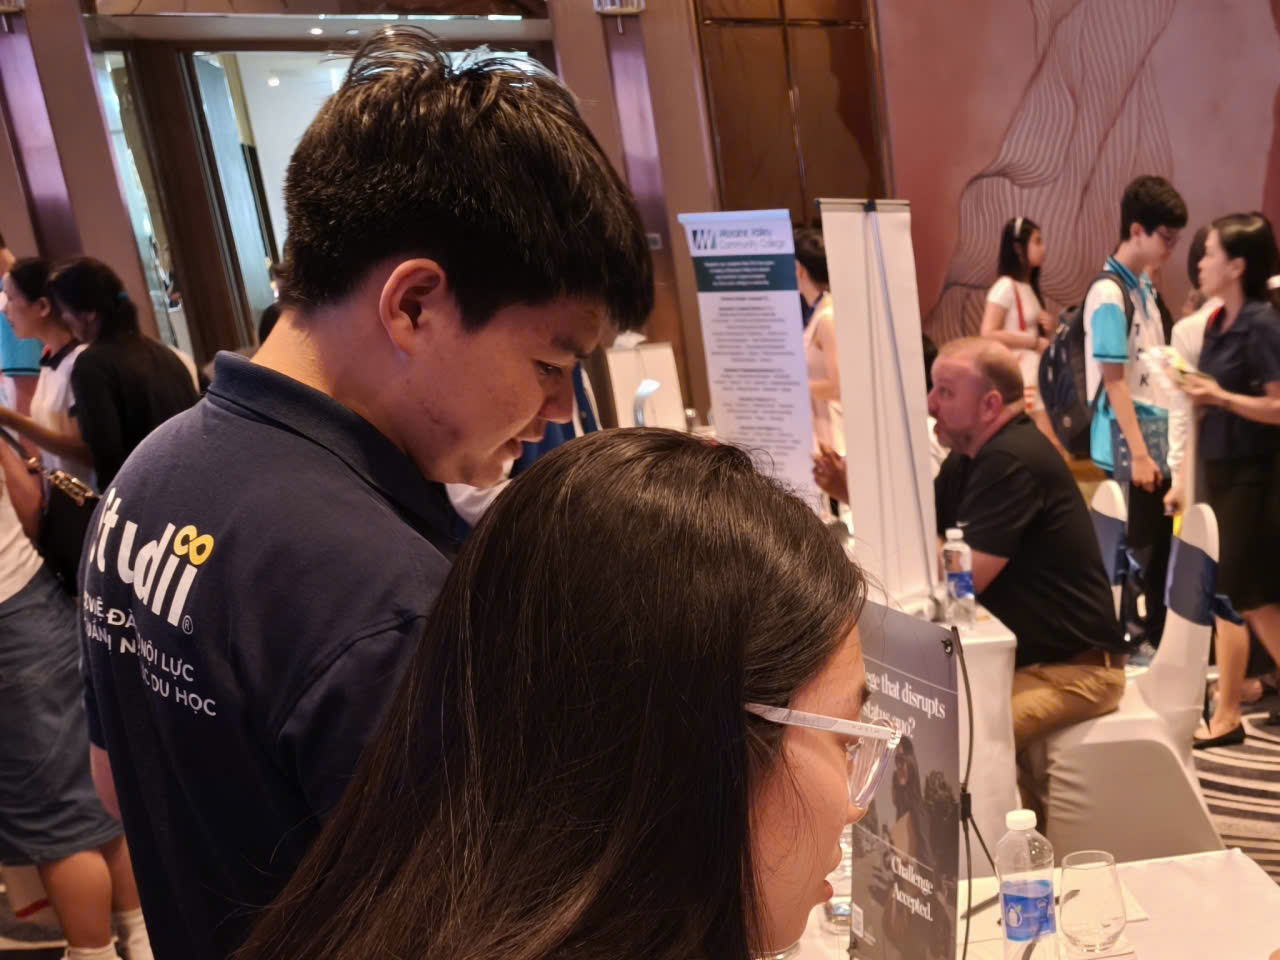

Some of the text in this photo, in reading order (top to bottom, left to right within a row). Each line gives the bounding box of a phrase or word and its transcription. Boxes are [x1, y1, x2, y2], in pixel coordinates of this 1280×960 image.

[175, 686, 217, 717] HỌC
[881, 671, 900, 700] that
[901, 682, 946, 719] disrupts
[891, 855, 934, 897] Challenge
